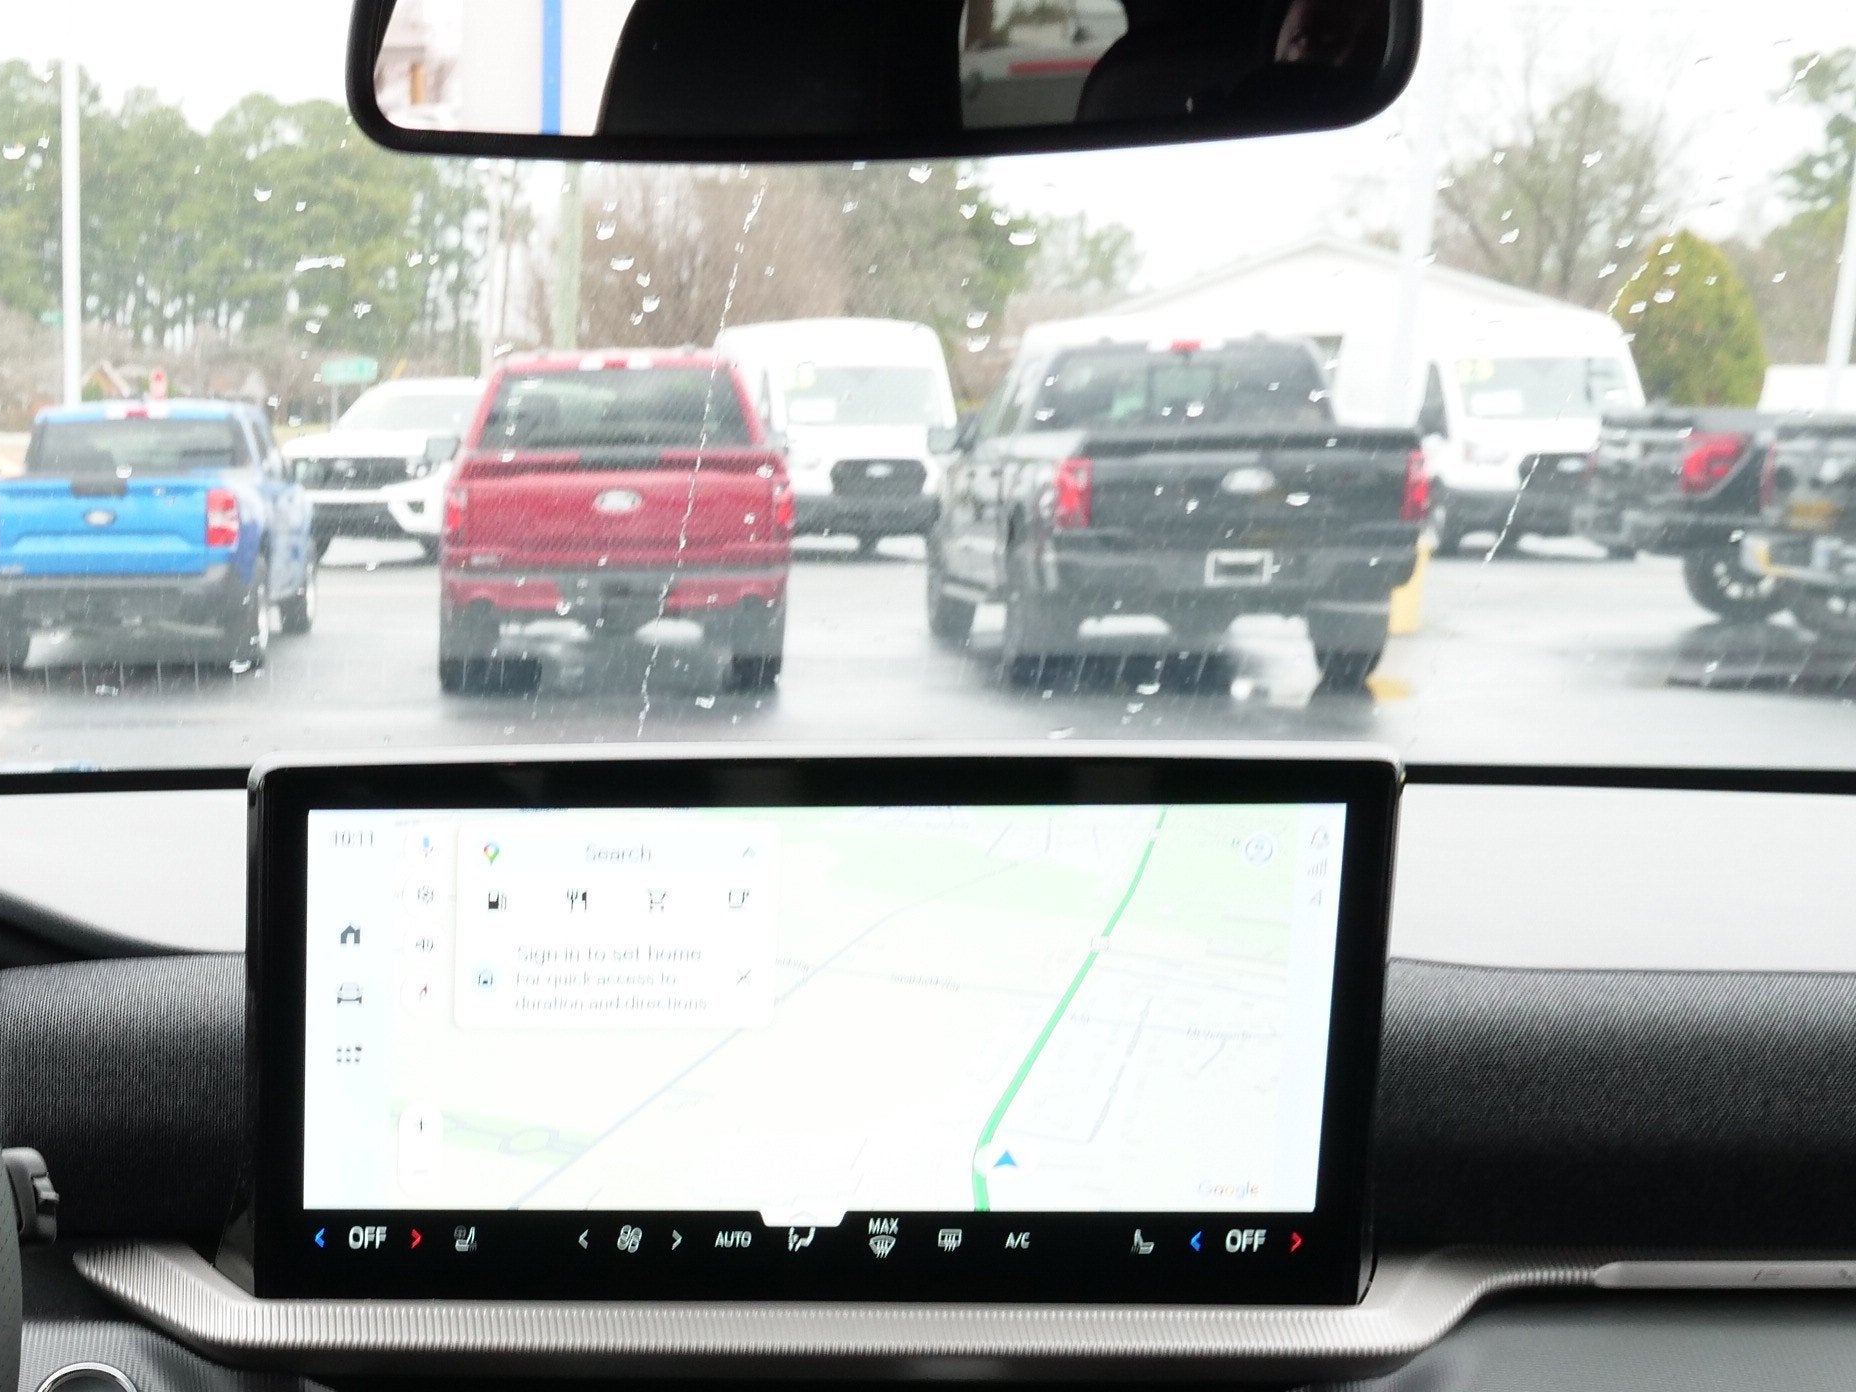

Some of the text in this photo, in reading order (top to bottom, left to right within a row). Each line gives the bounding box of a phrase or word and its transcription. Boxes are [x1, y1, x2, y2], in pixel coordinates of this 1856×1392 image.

[332, 830, 375, 848] 10:11
[586, 844, 652, 862] Search
[517, 945, 701, 965] Sign in to set home
[548, 972, 590, 989] quick
[597, 974, 654, 985] access
[661, 972, 677, 985] to
[515, 995, 708, 1012] duration and directions
[1196, 1179, 1260, 1199] Google
[867, 1217, 899, 1234] MAX
[348, 1226, 388, 1250] OFF
[715, 1231, 752, 1249] AUTO
[1005, 1231, 1030, 1250] A/C
[1225, 1228, 1266, 1253] OFF
